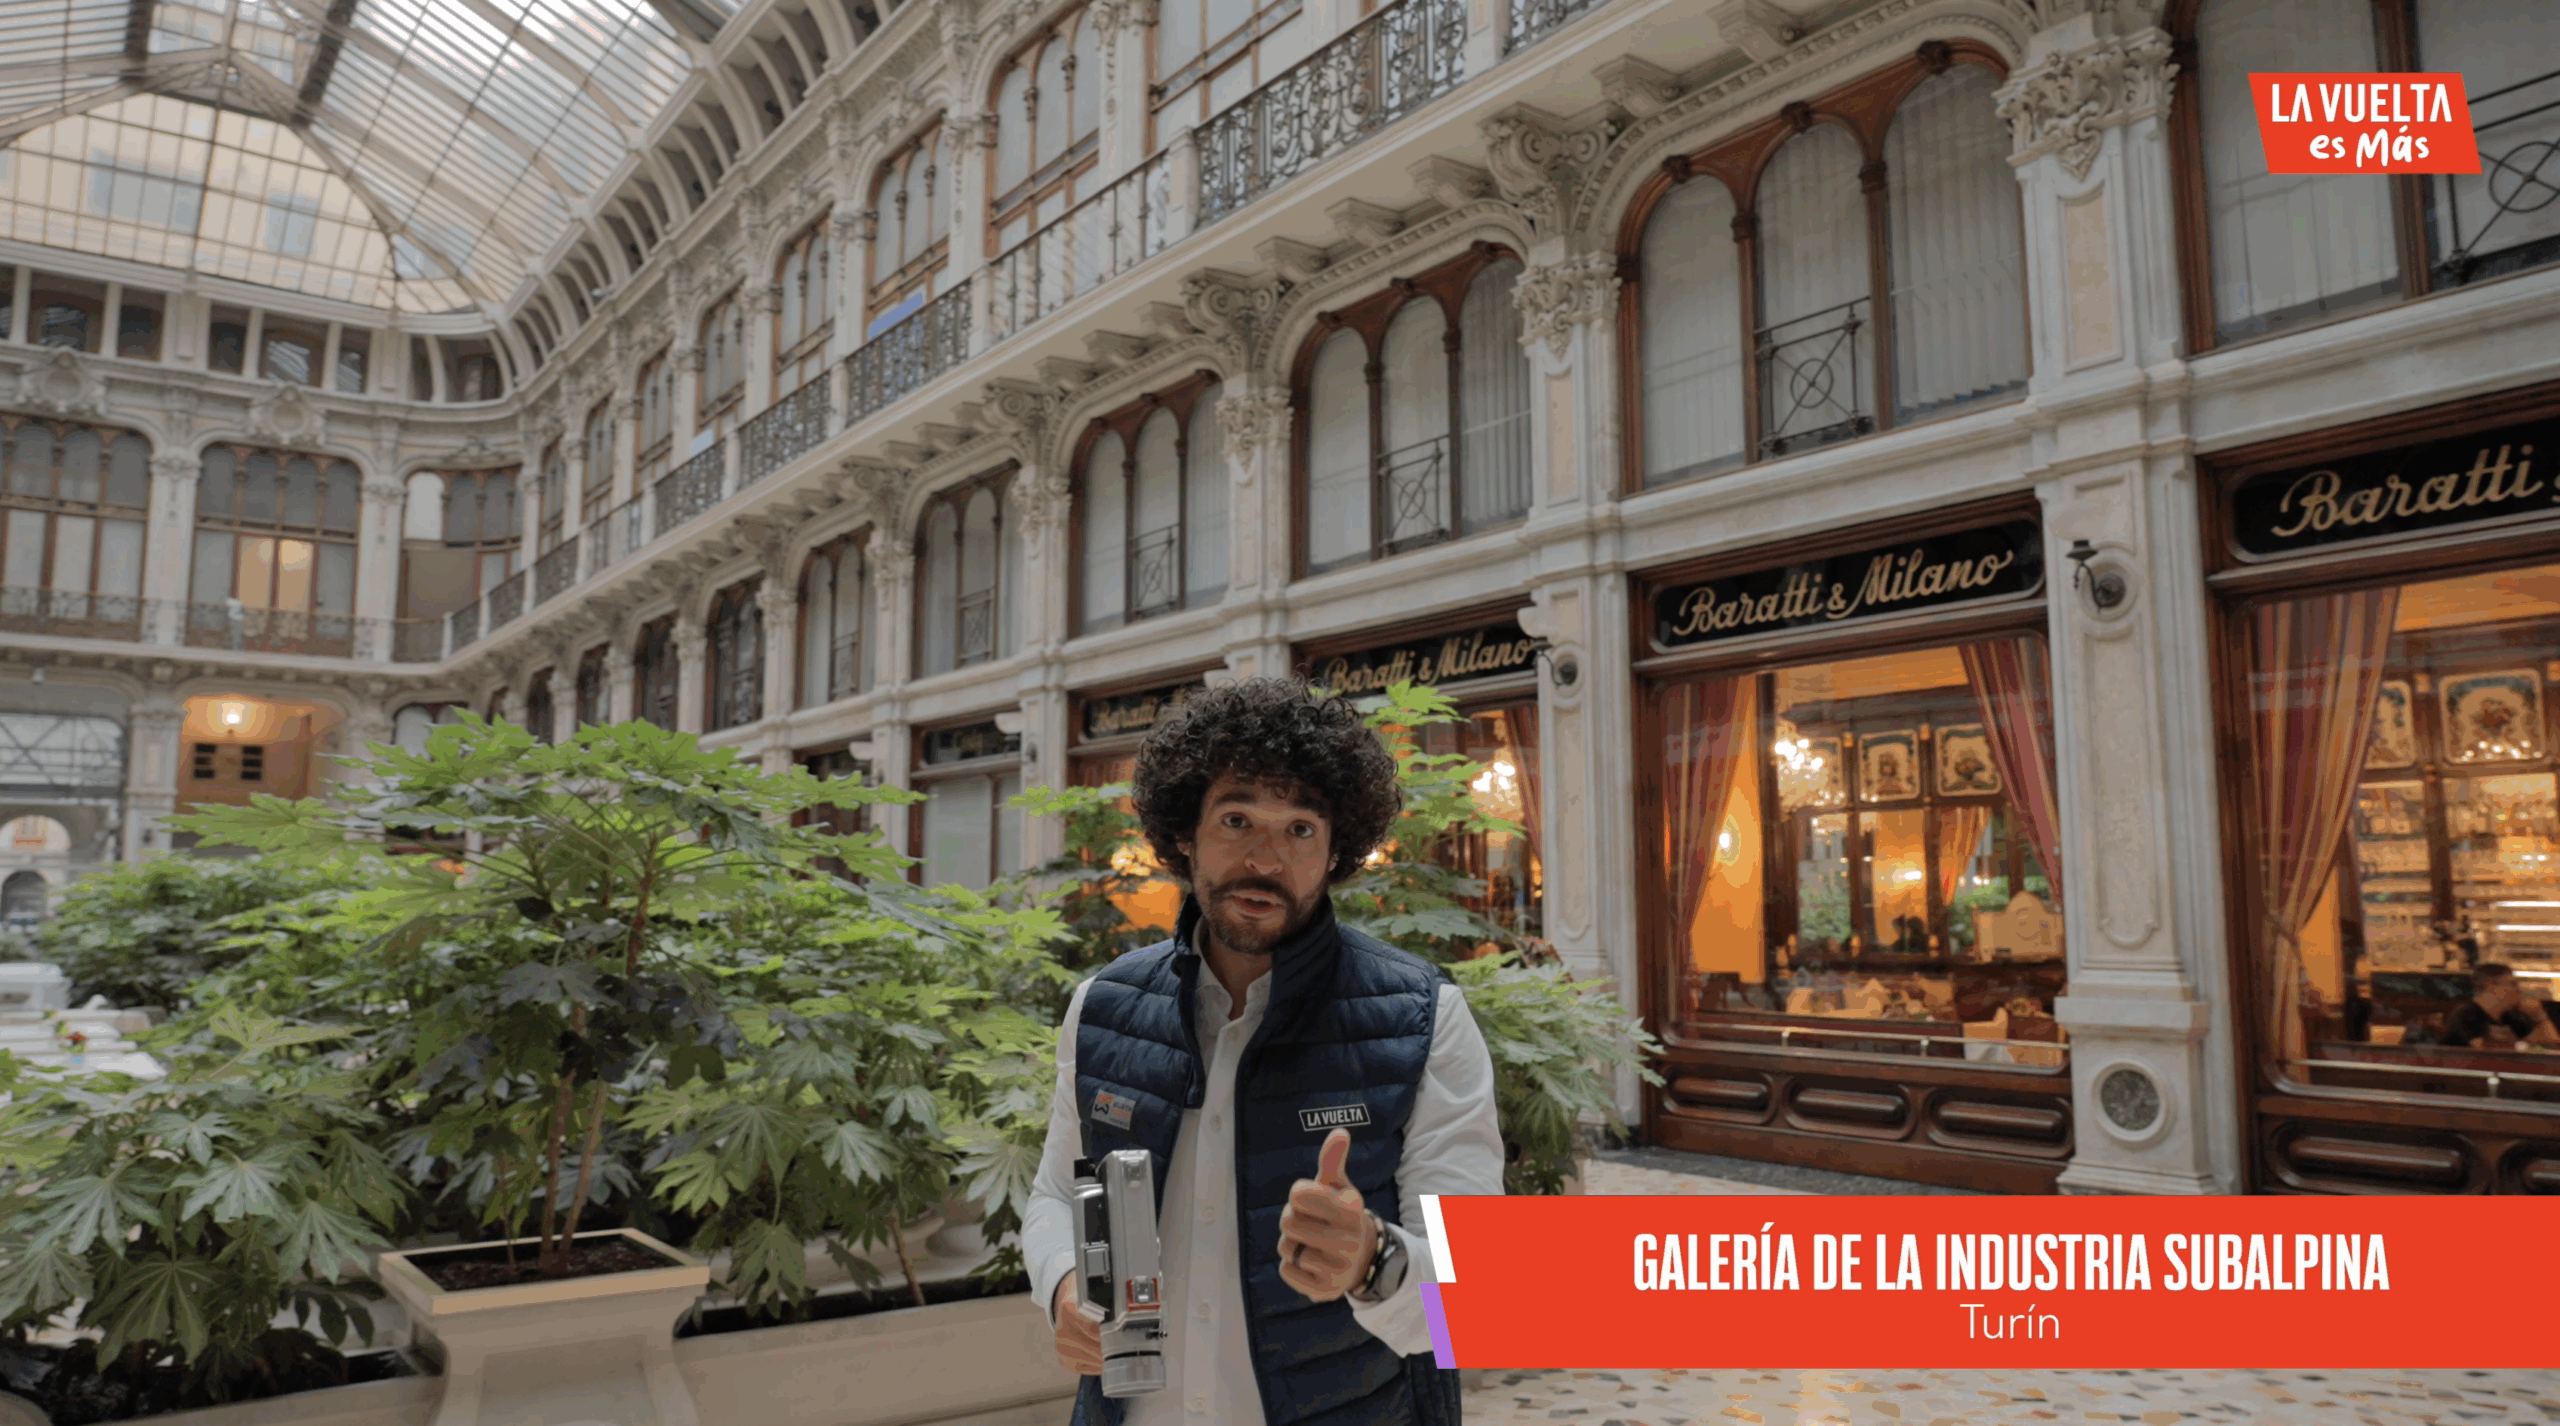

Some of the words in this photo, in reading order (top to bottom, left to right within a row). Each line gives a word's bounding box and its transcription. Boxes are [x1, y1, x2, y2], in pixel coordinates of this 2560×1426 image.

[2270, 444, 2544, 538] Baratti
[1672, 573, 1824, 637] Baratti
[1826, 547, 2014, 620] Milano
[1827, 583, 1848, 611] &
[1325, 650, 1416, 694] Baratti
[1416, 632, 1536, 686] Milano
[1306, 1112, 1322, 1127] LA
[1321, 1108, 1364, 1125] VUELTA
